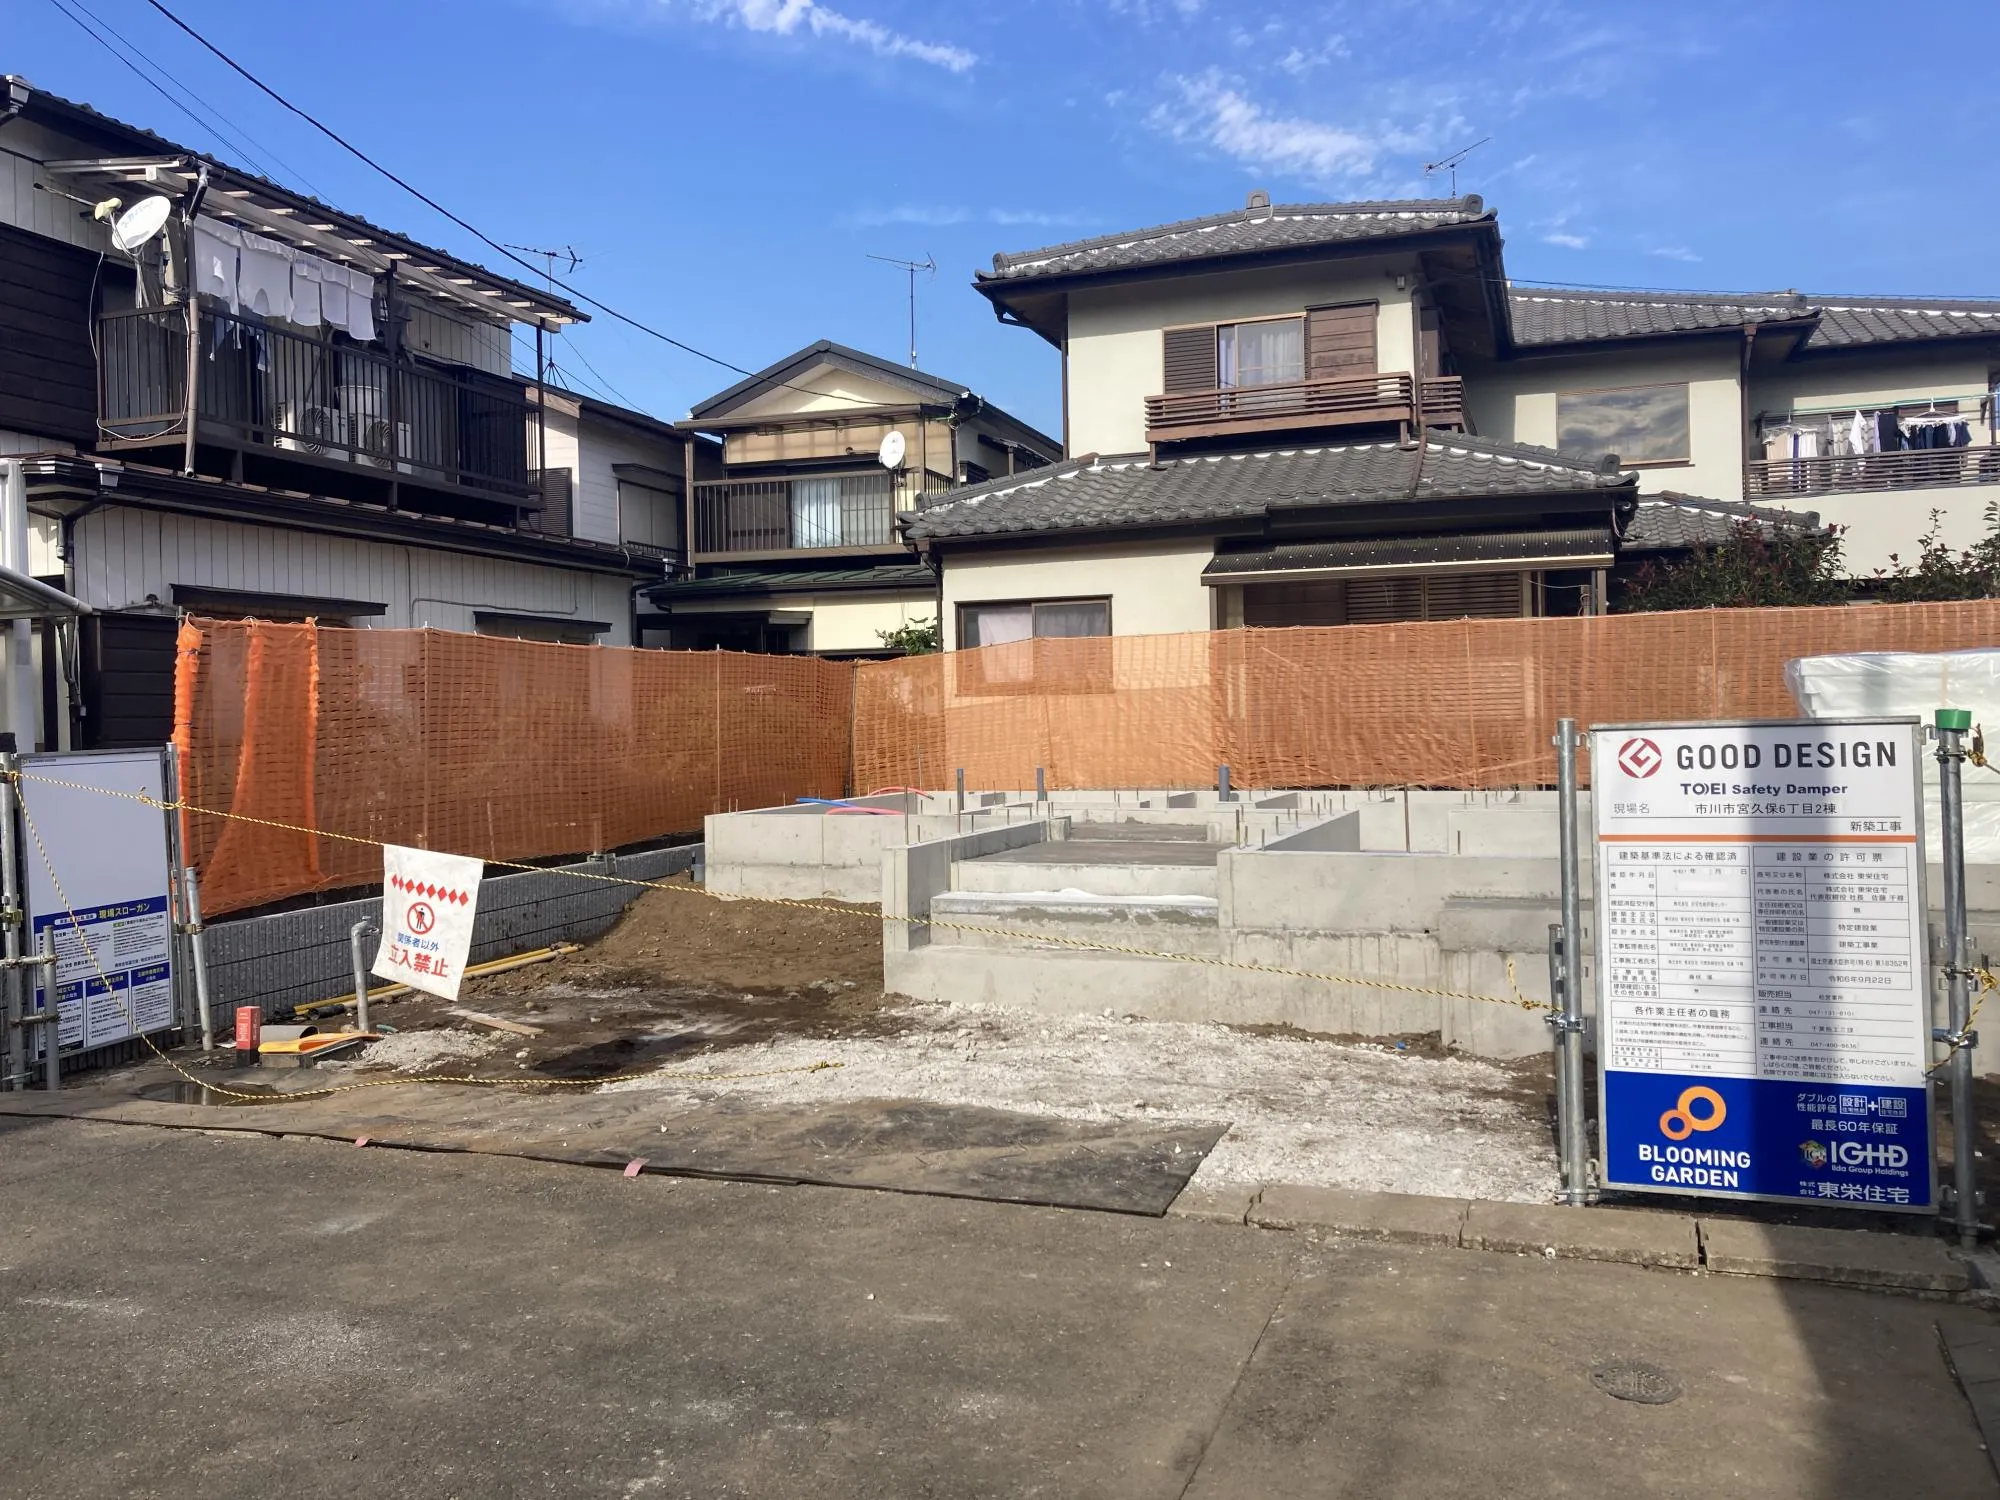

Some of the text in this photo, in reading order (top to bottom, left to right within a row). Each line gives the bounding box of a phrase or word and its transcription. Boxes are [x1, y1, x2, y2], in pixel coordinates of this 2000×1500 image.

[1677, 741, 1896, 770] GOOD DESIGN
[1732, 784, 1780, 796] Safety
[1787, 783, 1848, 796] Damper
[1614, 803, 1838, 815] 現場名 市川市宮久保6丁目2棟
[1850, 820, 1902, 832] 新築工事
[1619, 851, 1737, 860] 建築基準法による確認済
[1776, 852, 1883, 862] 建設業の許可票
[1824, 872, 1854, 880] 株式会社
[98, 902, 150, 919] 現場スローガン
[397, 932, 440, 952] 関係者以外
[388, 944, 449, 978] 立入禁止
[1758, 990, 1792, 998] 販売担当
[1634, 1006, 1731, 1020] 各作業主任者の職務
[1758, 1006, 1793, 1015] 連絡先
[1760, 1022, 1793, 1031] 工事担当
[1797, 1093, 1836, 1104] ダブルの
[1842, 1097, 1904, 1110] 設計 建設
[1796, 1102, 1838, 1114] 性能評価
[1811, 1119, 1898, 1135] 最長60年保証
[1638, 1144, 1751, 1169] BLOOMING
[1651, 1164, 1739, 1188] GARDEN
[1848, 1166, 1873, 1175] Group
[1875, 1168, 1909, 1177] Holdings
[1817, 1182, 1910, 1204] 東栄住宅
